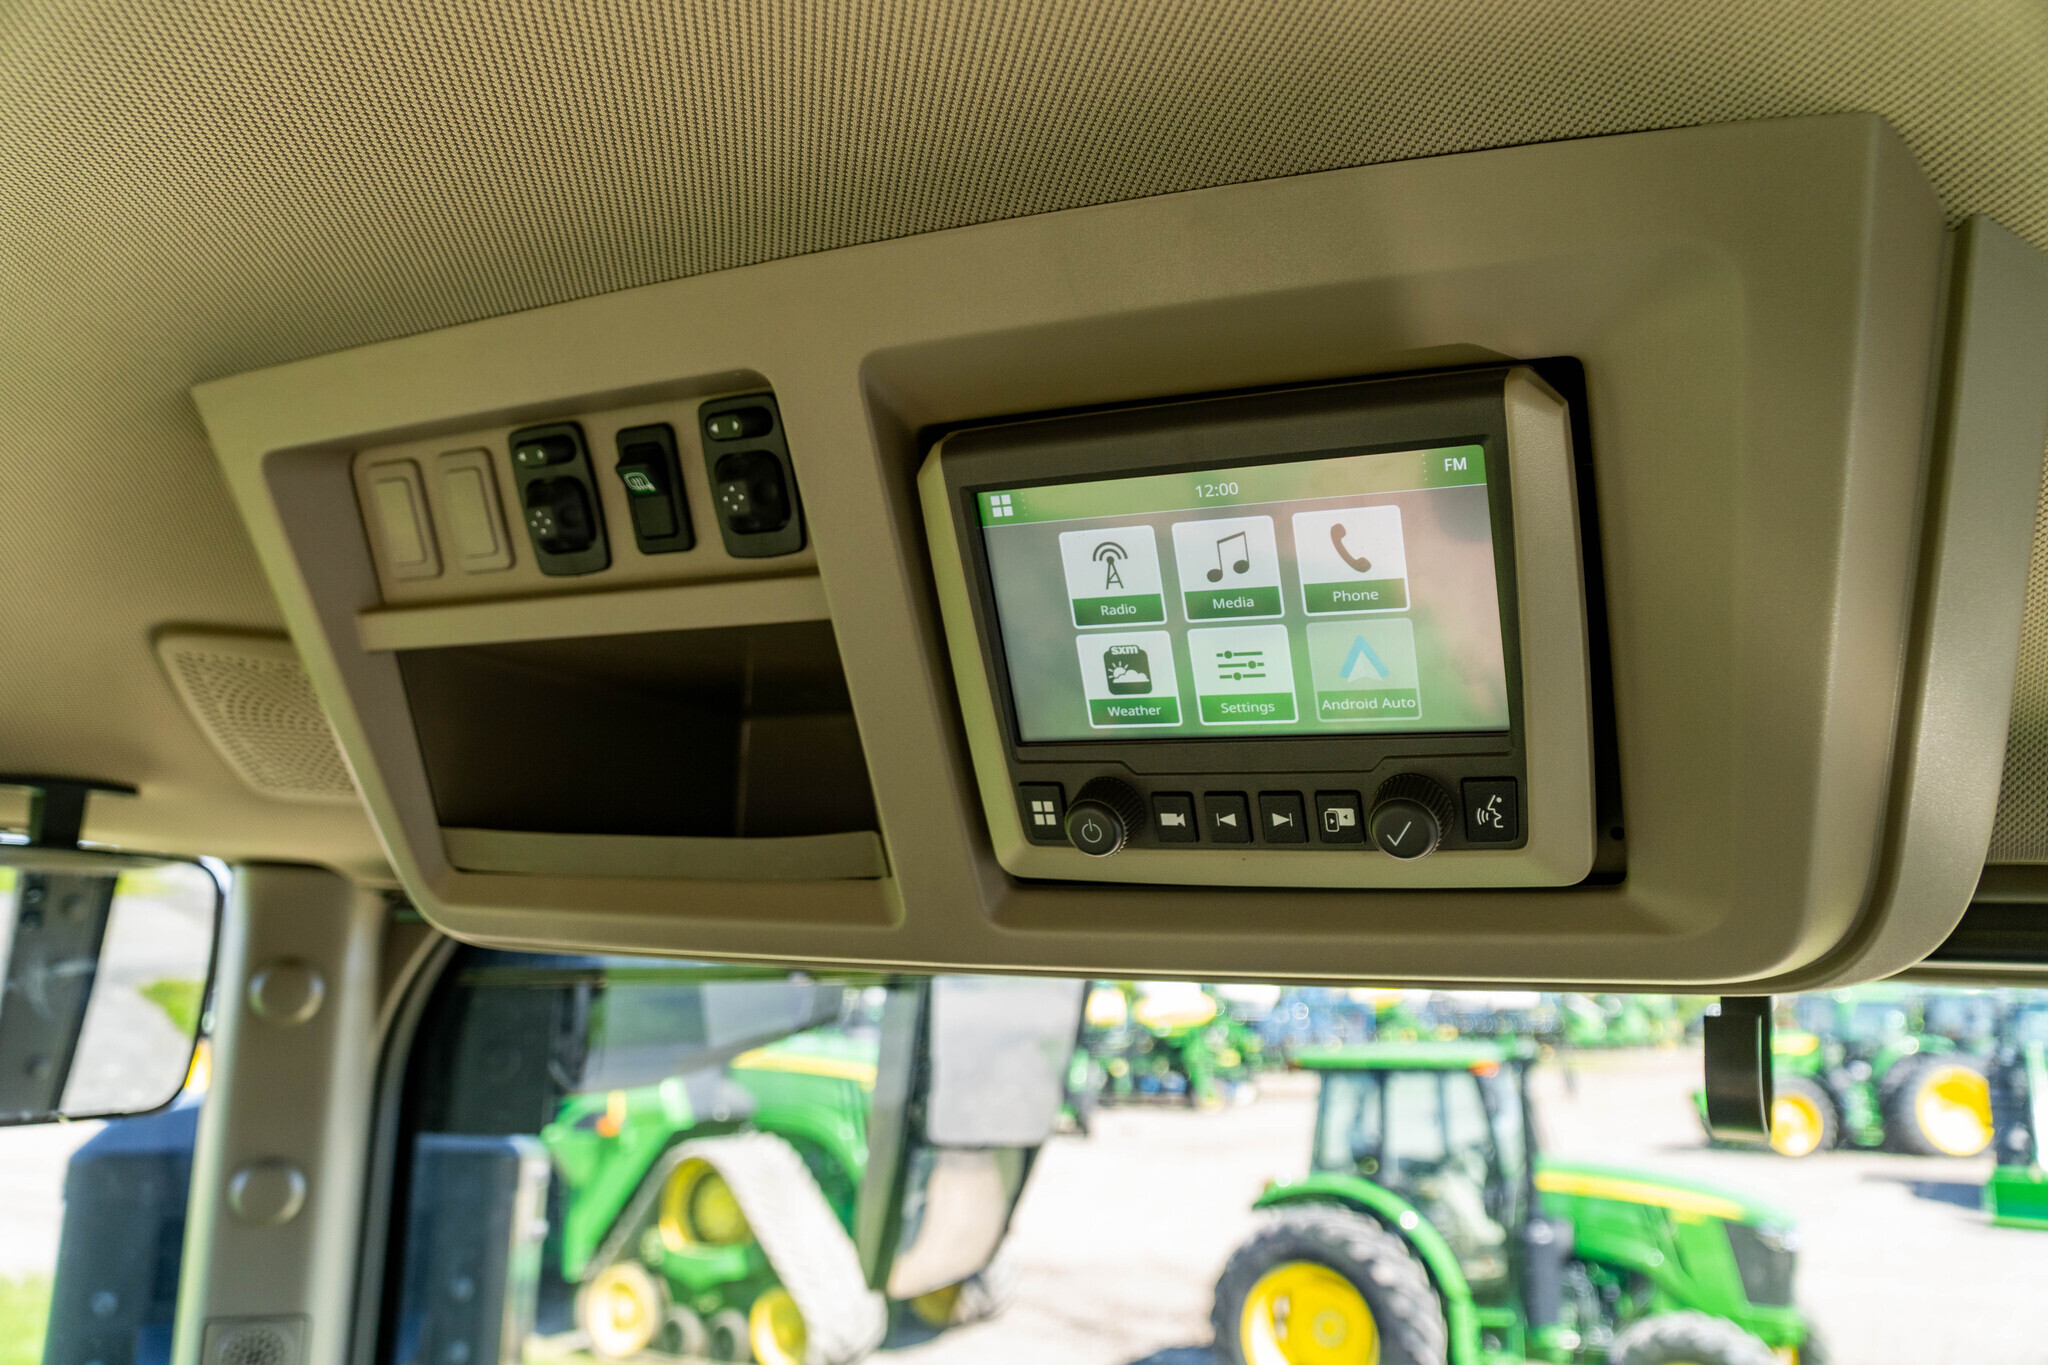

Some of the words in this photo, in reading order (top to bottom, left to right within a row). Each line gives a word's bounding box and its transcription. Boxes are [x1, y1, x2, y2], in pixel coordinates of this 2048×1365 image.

[1444, 456, 1468, 472] FM
[1195, 481, 1239, 498] 12:00
[1332, 590, 1379, 603] Phone
[1100, 604, 1137, 616] Radio
[1212, 597, 1255, 610] Media
[1110, 645, 1139, 655] sxm
[1220, 702, 1275, 715] Settings
[1321, 698, 1378, 710] Android
[1381, 698, 1416, 709] Auto
[1107, 705, 1161, 717] Weather
